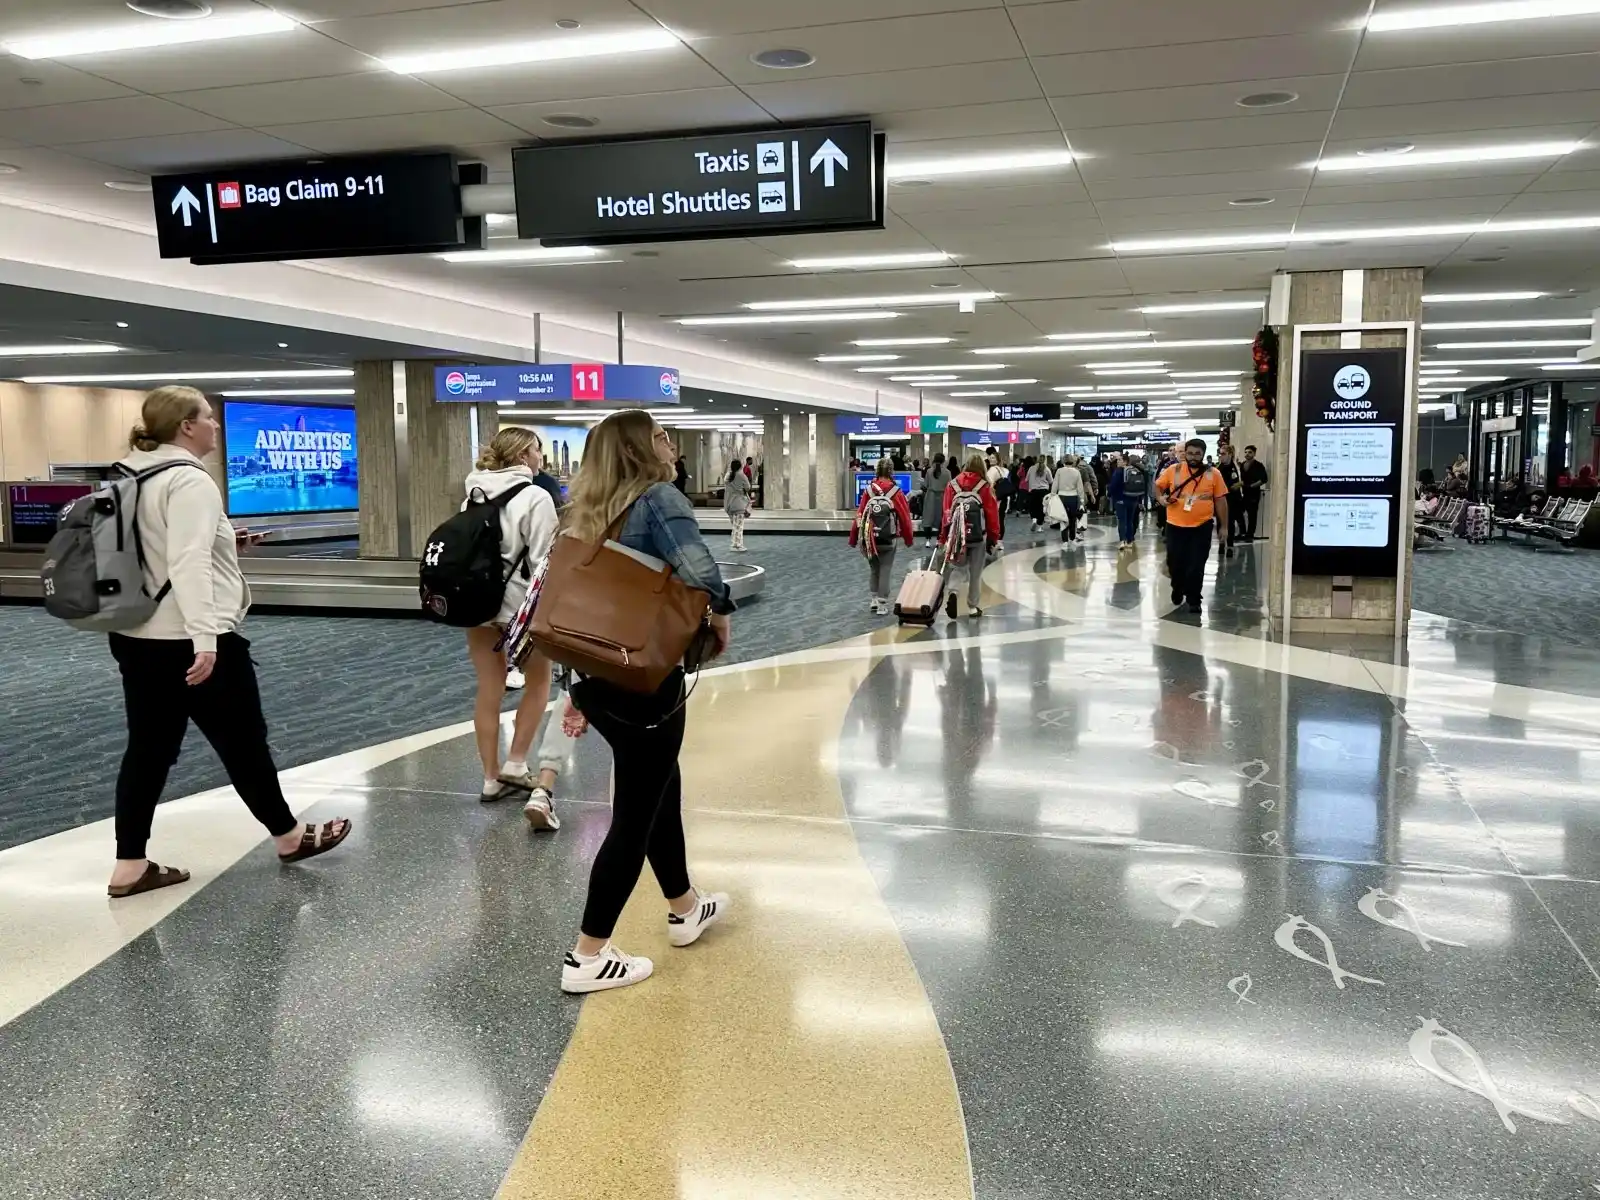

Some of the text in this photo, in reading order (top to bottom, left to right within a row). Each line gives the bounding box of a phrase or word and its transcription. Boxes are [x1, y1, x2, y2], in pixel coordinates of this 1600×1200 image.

[694, 149, 750, 174] Taxis
[245, 175, 384, 207] Bag Claim 9-11
[597, 188, 752, 218] Hotel Shuttles
[466, 379, 497, 388] International
[518, 373, 554, 383] 10:56 AM
[575, 371, 599, 391] 11
[465, 387, 483, 396] Airport
[518, 386, 546, 394] November
[1330, 400, 1372, 409] GROUND
[1323, 410, 1379, 420] TRANSPORT
[907, 418, 920, 429] 10
[254, 429, 352, 451] ADVERTISE
[268, 450, 342, 470] WITH US
[12, 486, 28, 502] 11
[425, 553, 439, 566] 44
[44, 577, 55, 596] 33
